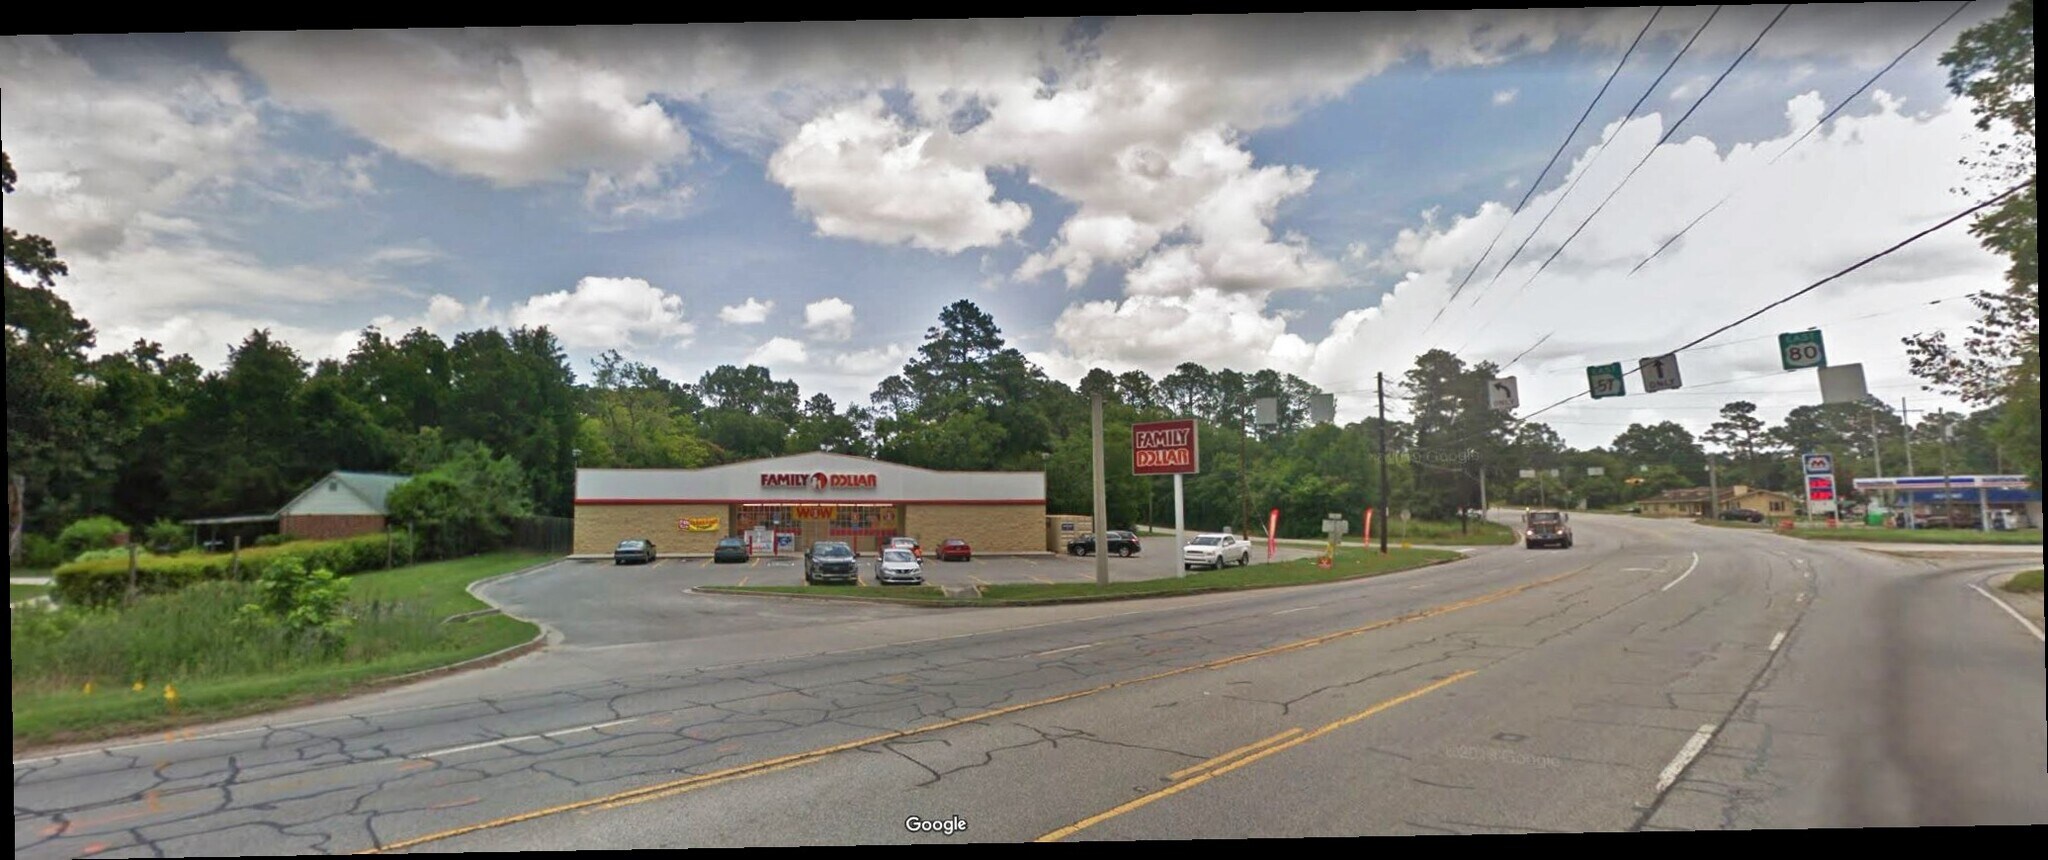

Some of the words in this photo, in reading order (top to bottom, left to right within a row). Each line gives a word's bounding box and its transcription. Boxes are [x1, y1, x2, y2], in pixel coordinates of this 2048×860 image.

[1789, 346, 1817, 361] 80
[1136, 427, 1190, 449] FAMILY
[1136, 448, 1190, 468] DOLLAR
[761, 474, 810, 487] FAMILY
[830, 474, 877, 487] DOLLAR
[796, 506, 833, 519] WOW
